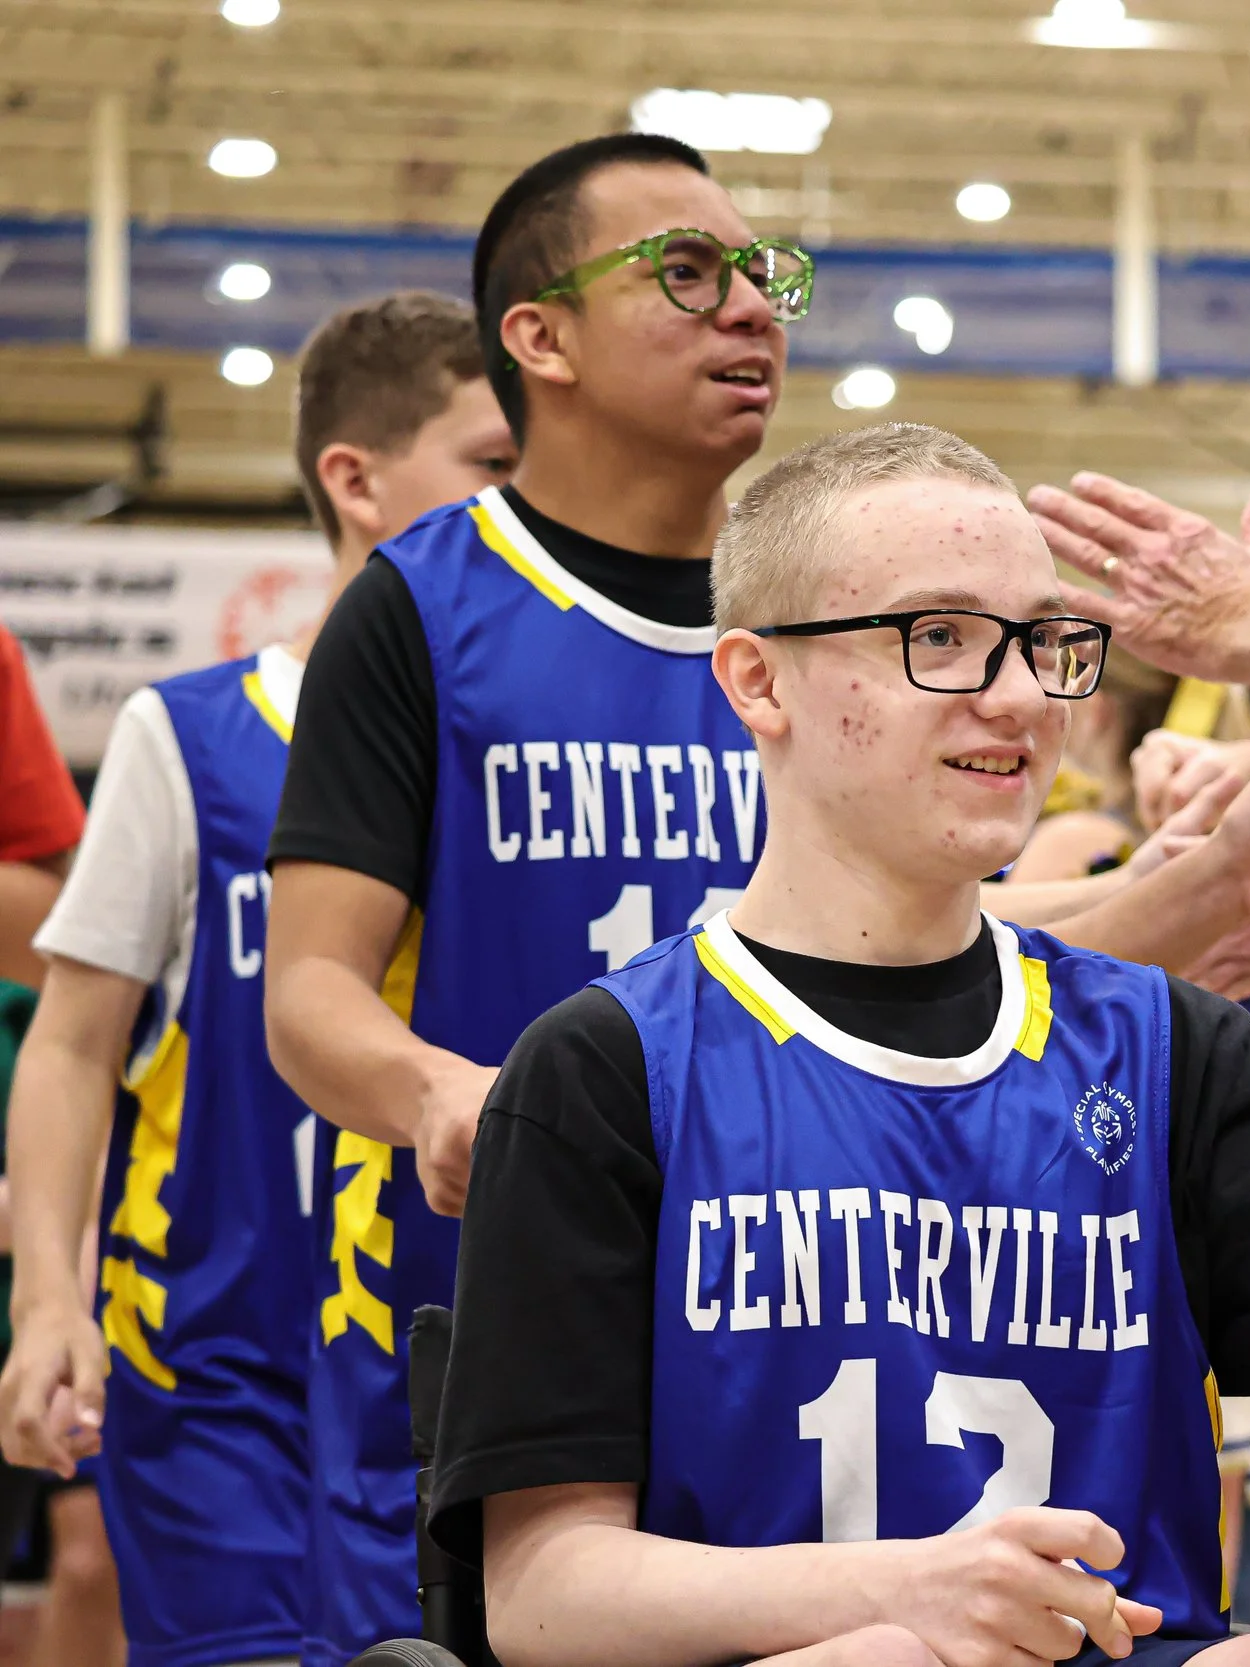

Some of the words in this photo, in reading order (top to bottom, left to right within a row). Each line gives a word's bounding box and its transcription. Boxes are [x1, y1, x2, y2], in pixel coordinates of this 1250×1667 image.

[484, 741, 763, 863] CENTERV
[1073, 1084, 1102, 1135] SPECIAL
[1085, 1145, 1107, 1173] PLA
[684, 1187, 1150, 1352] CENTERVILLE
[798, 1357, 1055, 1544] 12
